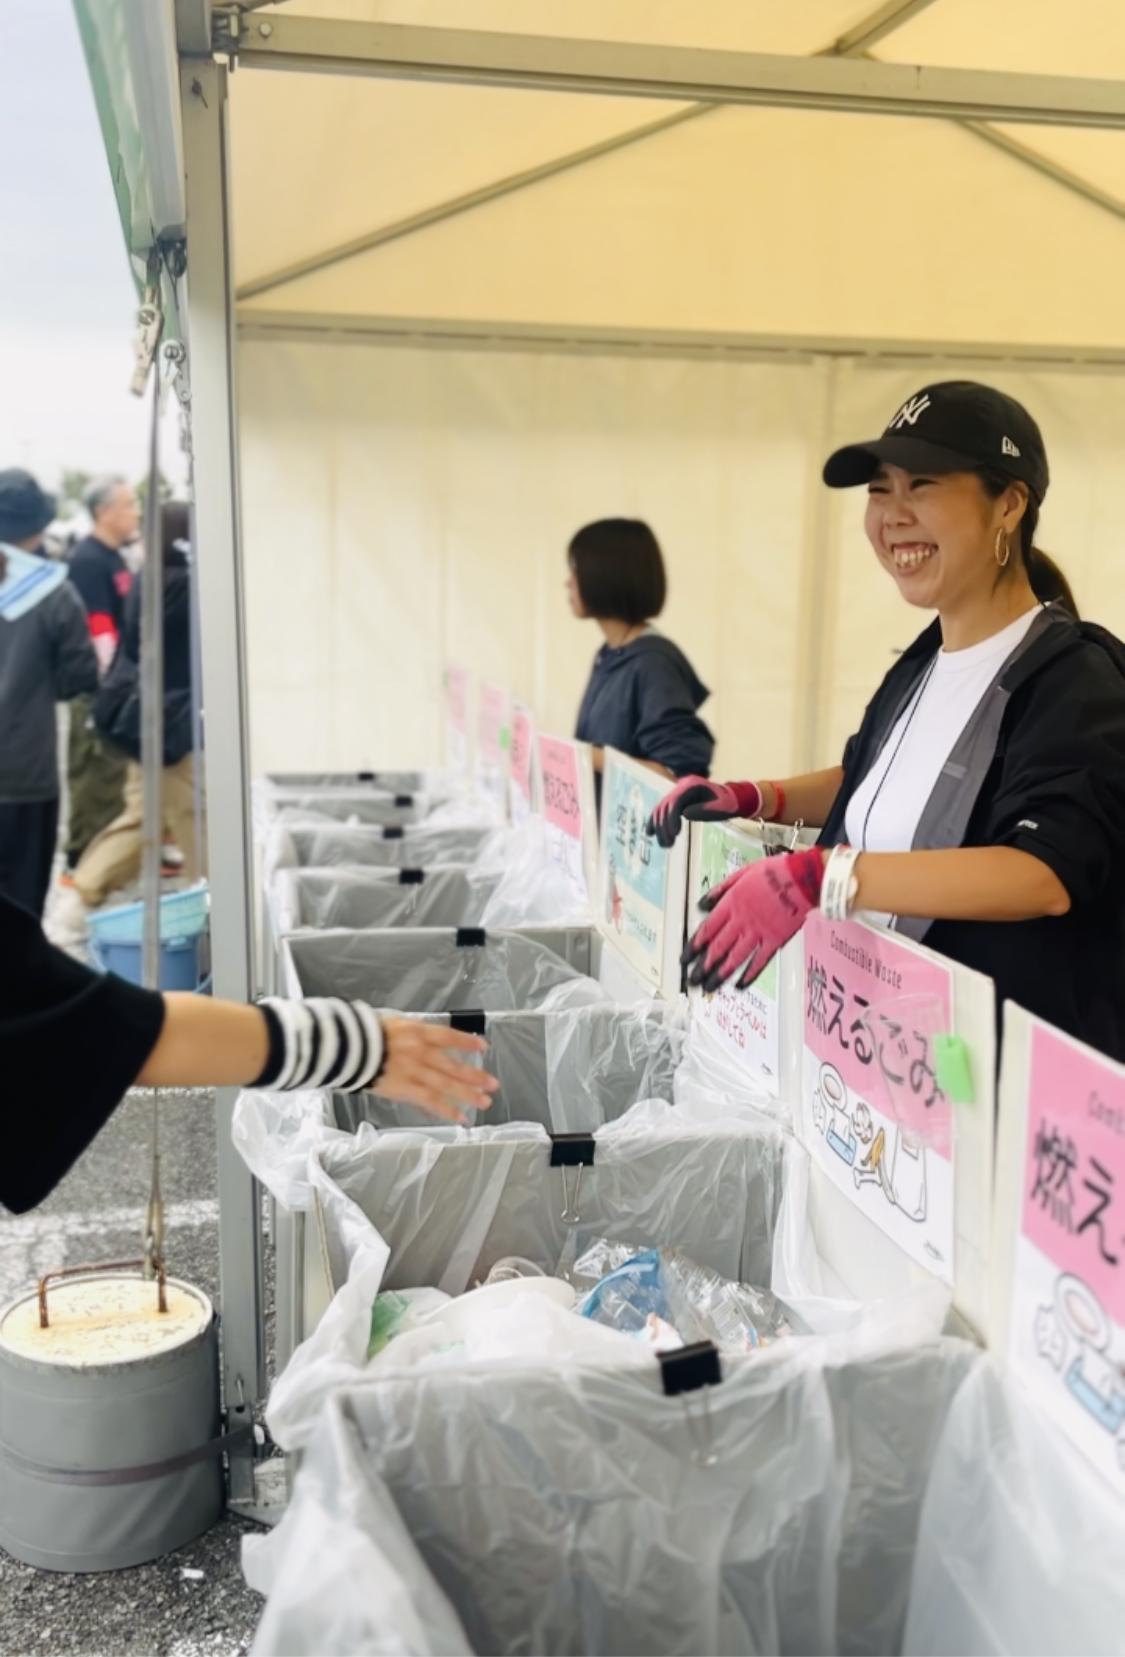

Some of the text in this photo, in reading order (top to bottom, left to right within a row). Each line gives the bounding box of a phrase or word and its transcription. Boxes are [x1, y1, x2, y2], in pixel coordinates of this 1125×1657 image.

[889, 393, 931, 430] NY
[830, 929, 902, 989] Combustible Waste
[806, 956, 945, 1108] 燃えるごみ
[1031, 1117, 1125, 1267] 燃え
